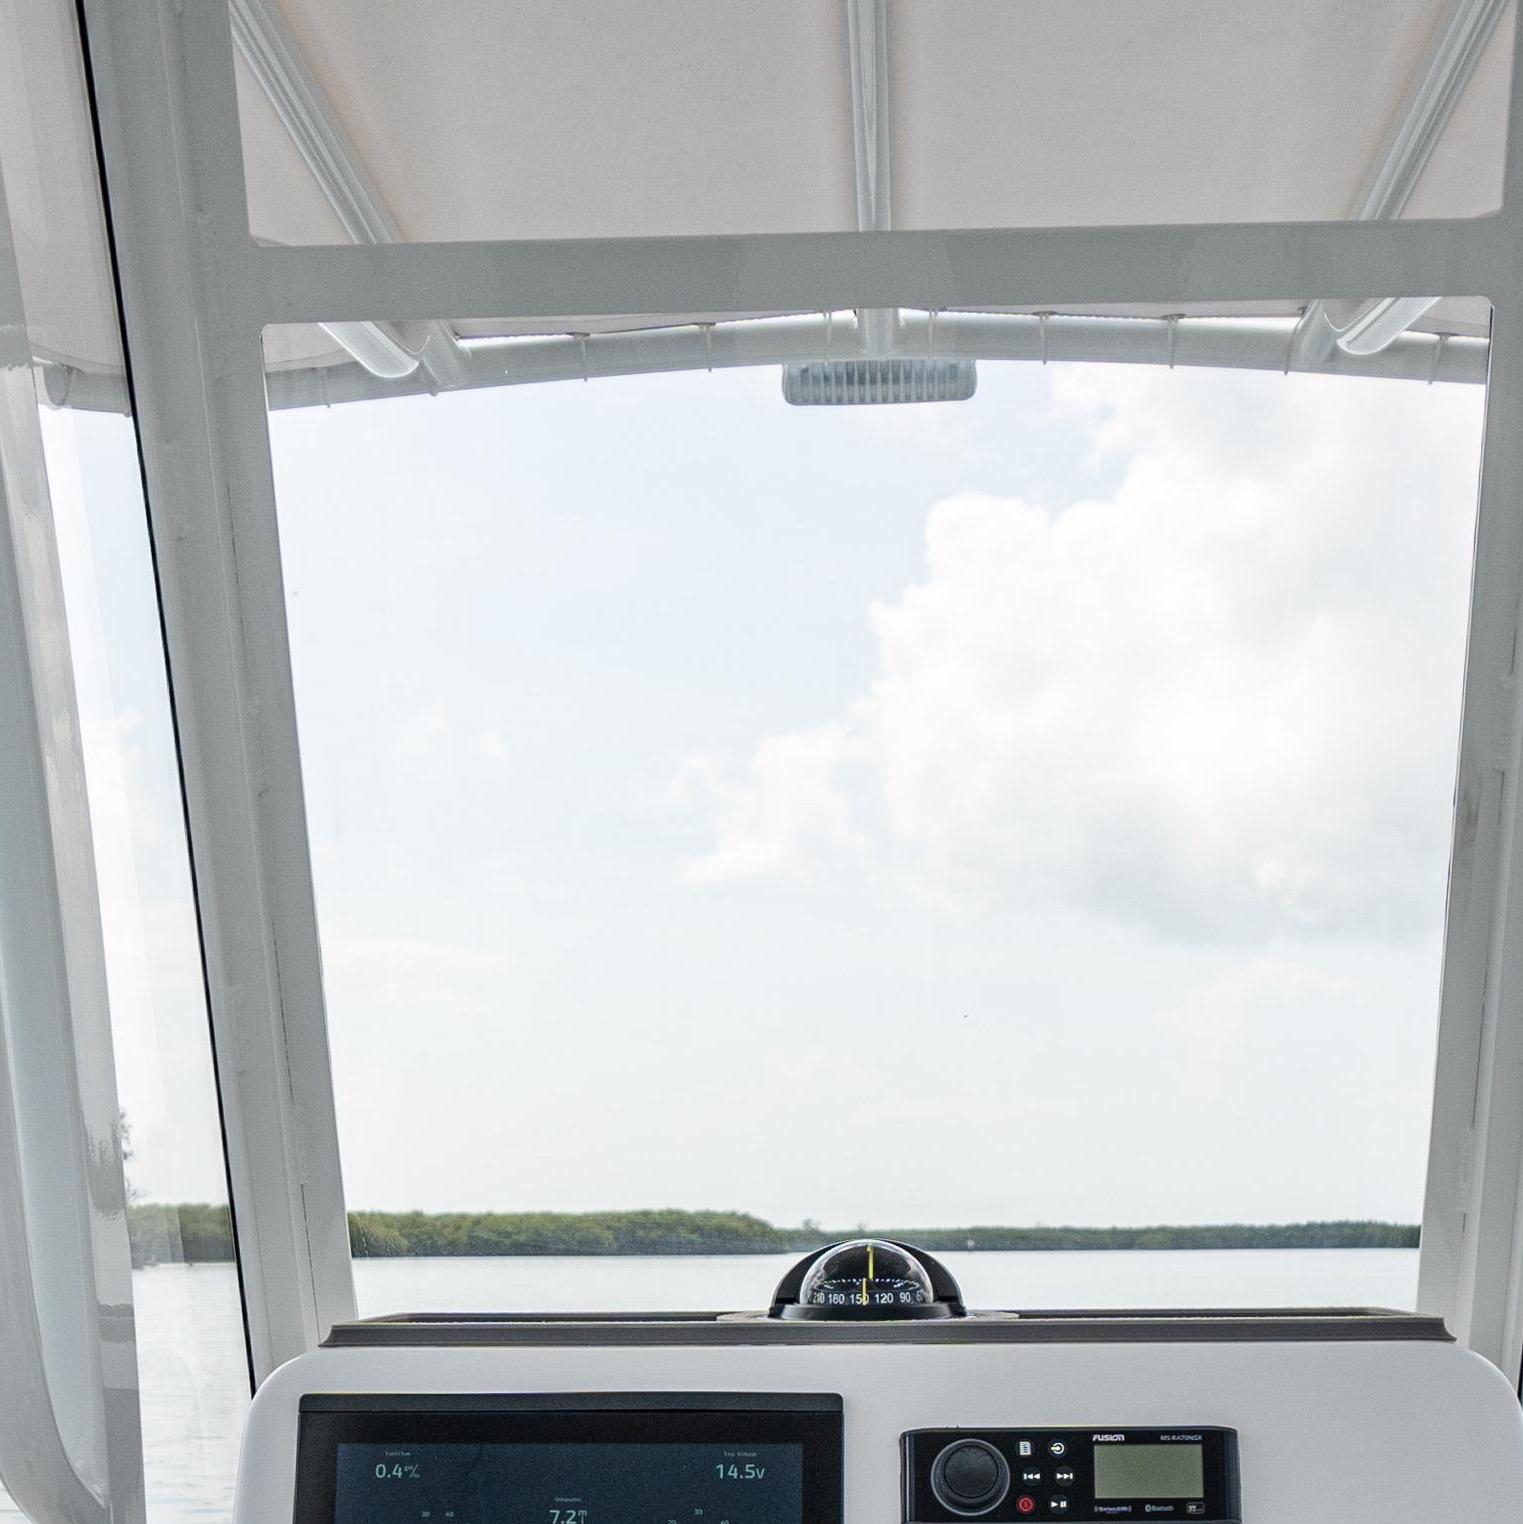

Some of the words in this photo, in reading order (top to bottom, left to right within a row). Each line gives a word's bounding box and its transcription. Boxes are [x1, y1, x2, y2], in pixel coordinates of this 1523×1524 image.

[828, 1293, 845, 1304] 180
[850, 1293, 869, 1304] 150
[874, 1292, 894, 1303] 120
[899, 1292, 911, 1302] 90
[1092, 1434, 1125, 1442] FUSION
